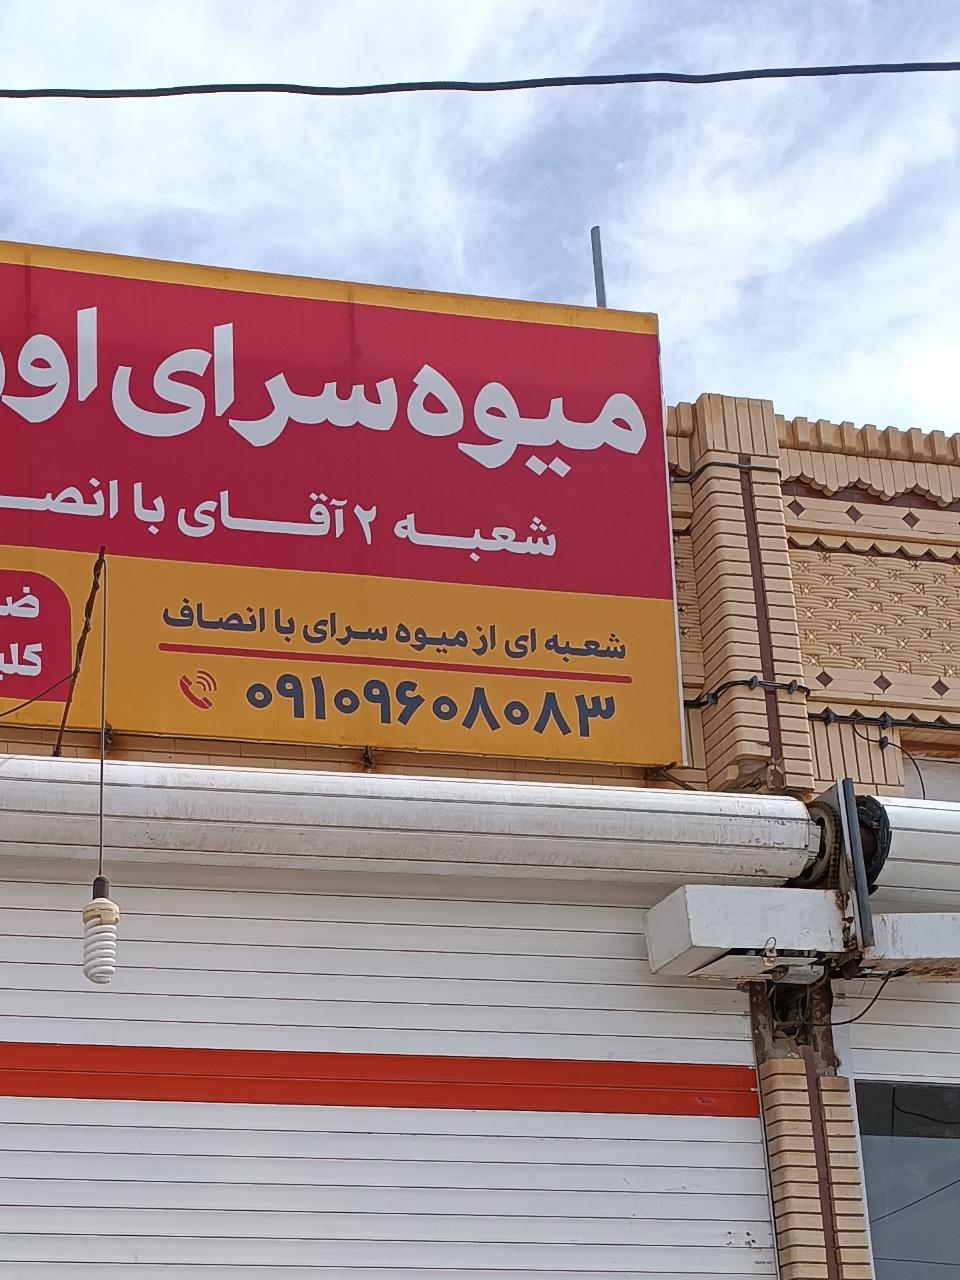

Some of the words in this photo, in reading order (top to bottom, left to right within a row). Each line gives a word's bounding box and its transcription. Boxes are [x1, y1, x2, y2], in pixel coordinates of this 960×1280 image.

[111, 322, 398, 448] سرای
[407, 363, 647, 478] میوه
[133, 482, 166, 535] با
[177, 489, 348, 539] آقای
[353, 504, 378, 546] ۲
[393, 512, 558, 563] شعبه
[162, 598, 267, 635] انصاف
[274, 608, 296, 642] با
[303, 611, 388, 648] سرای
[396, 622, 468, 655] میوه
[472, 624, 496, 652] از
[504, 629, 537, 658] ای
[543, 633, 627, 667] شعبه
[246, 673, 616, 738] ۰۹۱۰۹۶۰۸۰۸۳
